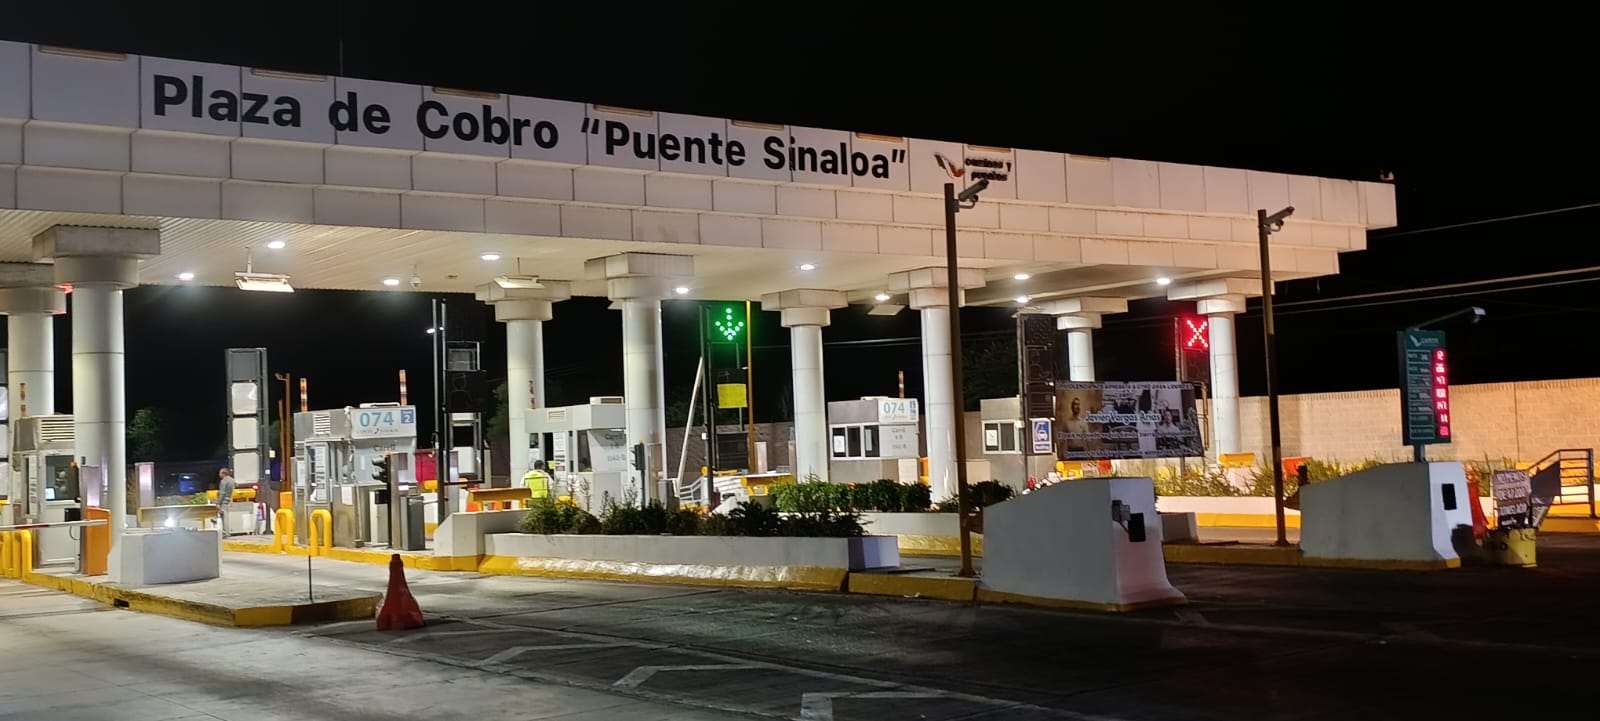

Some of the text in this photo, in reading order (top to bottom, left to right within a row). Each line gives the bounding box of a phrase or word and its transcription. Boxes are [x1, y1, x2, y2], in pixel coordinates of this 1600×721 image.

[153, 74, 302, 128] Plaza
[328, 91, 391, 135] de
[416, 99, 560, 150] Cobro
[884, 402, 905, 414] 074
[360, 411, 394, 427] 074
[404, 415, 411, 423] 2
[1085, 411, 1162, 425] Javier Vargas Arias
